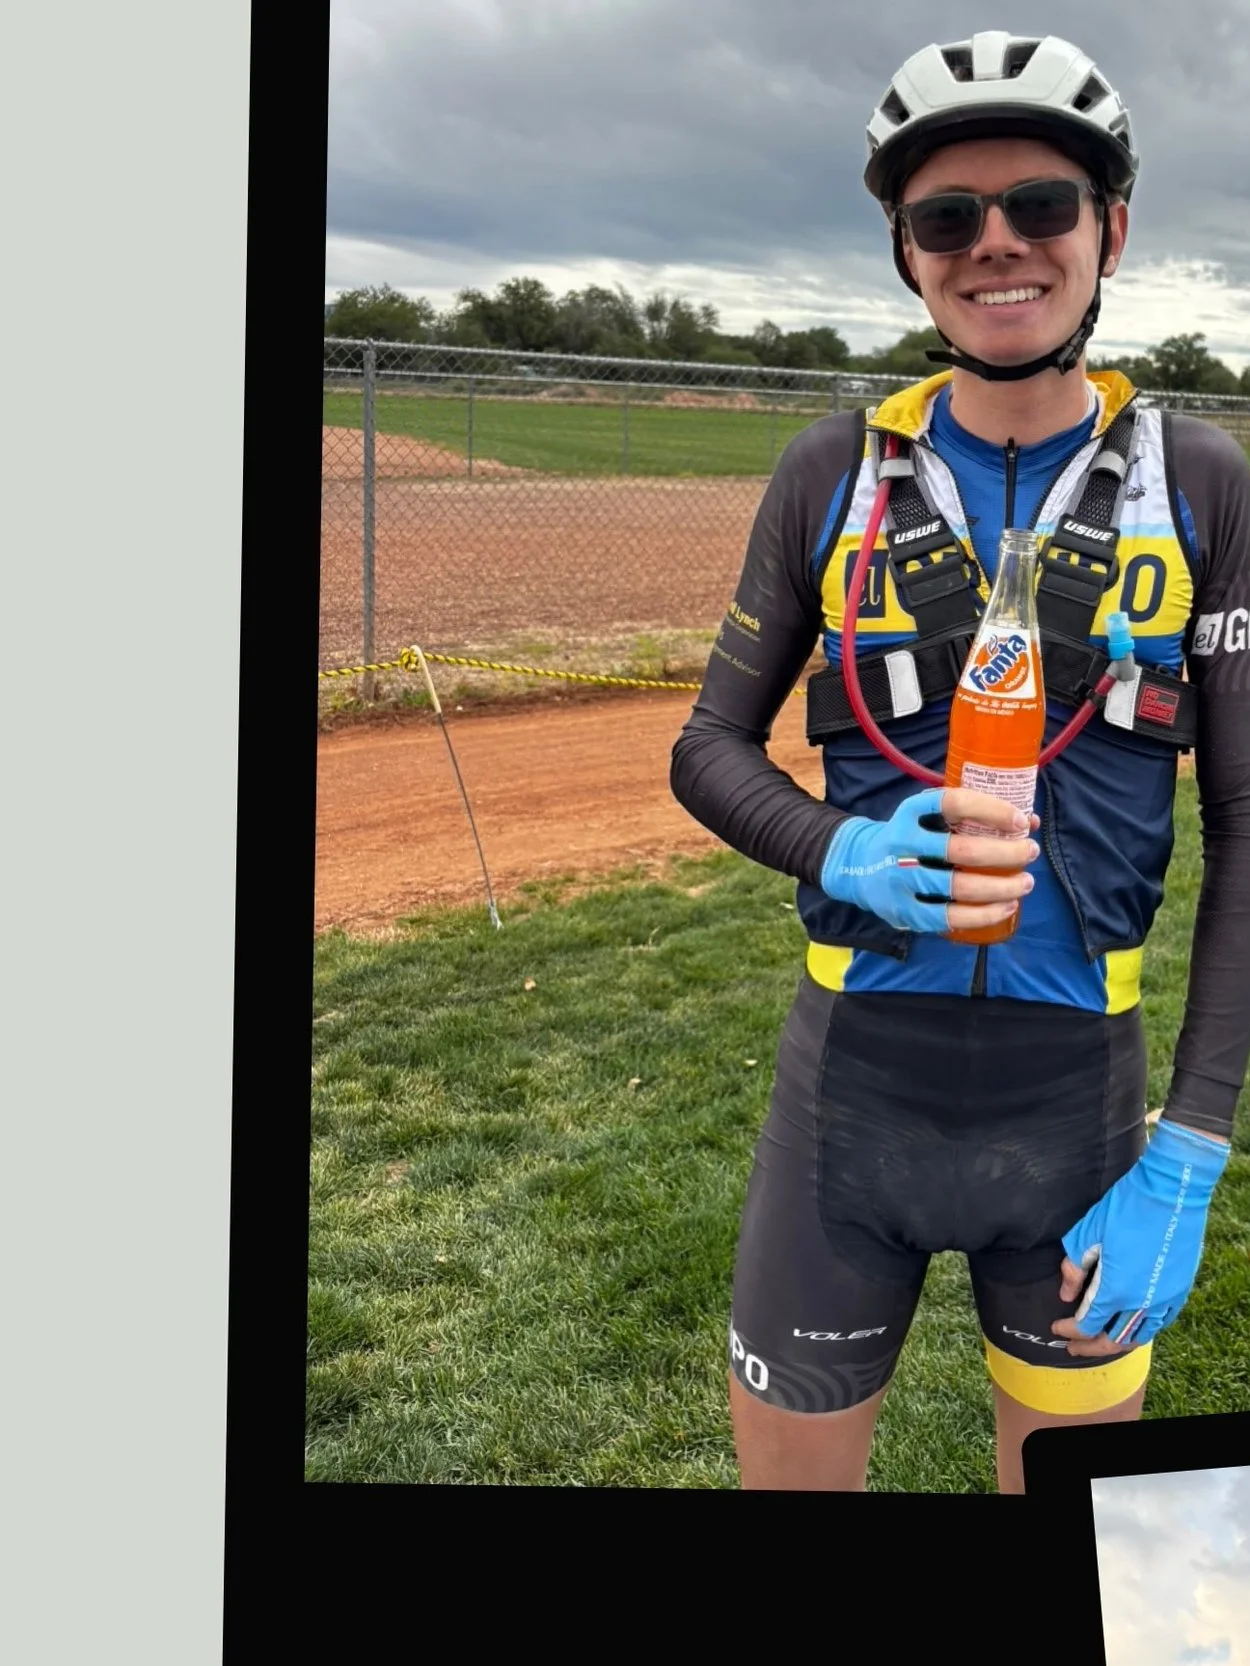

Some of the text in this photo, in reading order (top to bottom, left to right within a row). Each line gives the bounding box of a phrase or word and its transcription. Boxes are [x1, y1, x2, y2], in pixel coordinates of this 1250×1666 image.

[894, 520, 941, 545] USWE
[1063, 519, 1115, 542] USWE
[735, 606, 761, 632] Lynch
[1195, 624, 1216, 649] el
[969, 635, 1027, 692] Fanta
[1164, 1216, 1179, 1242] ITALY
[793, 1326, 888, 1341] VOLER
[1003, 1325, 1070, 1349] VOLE
